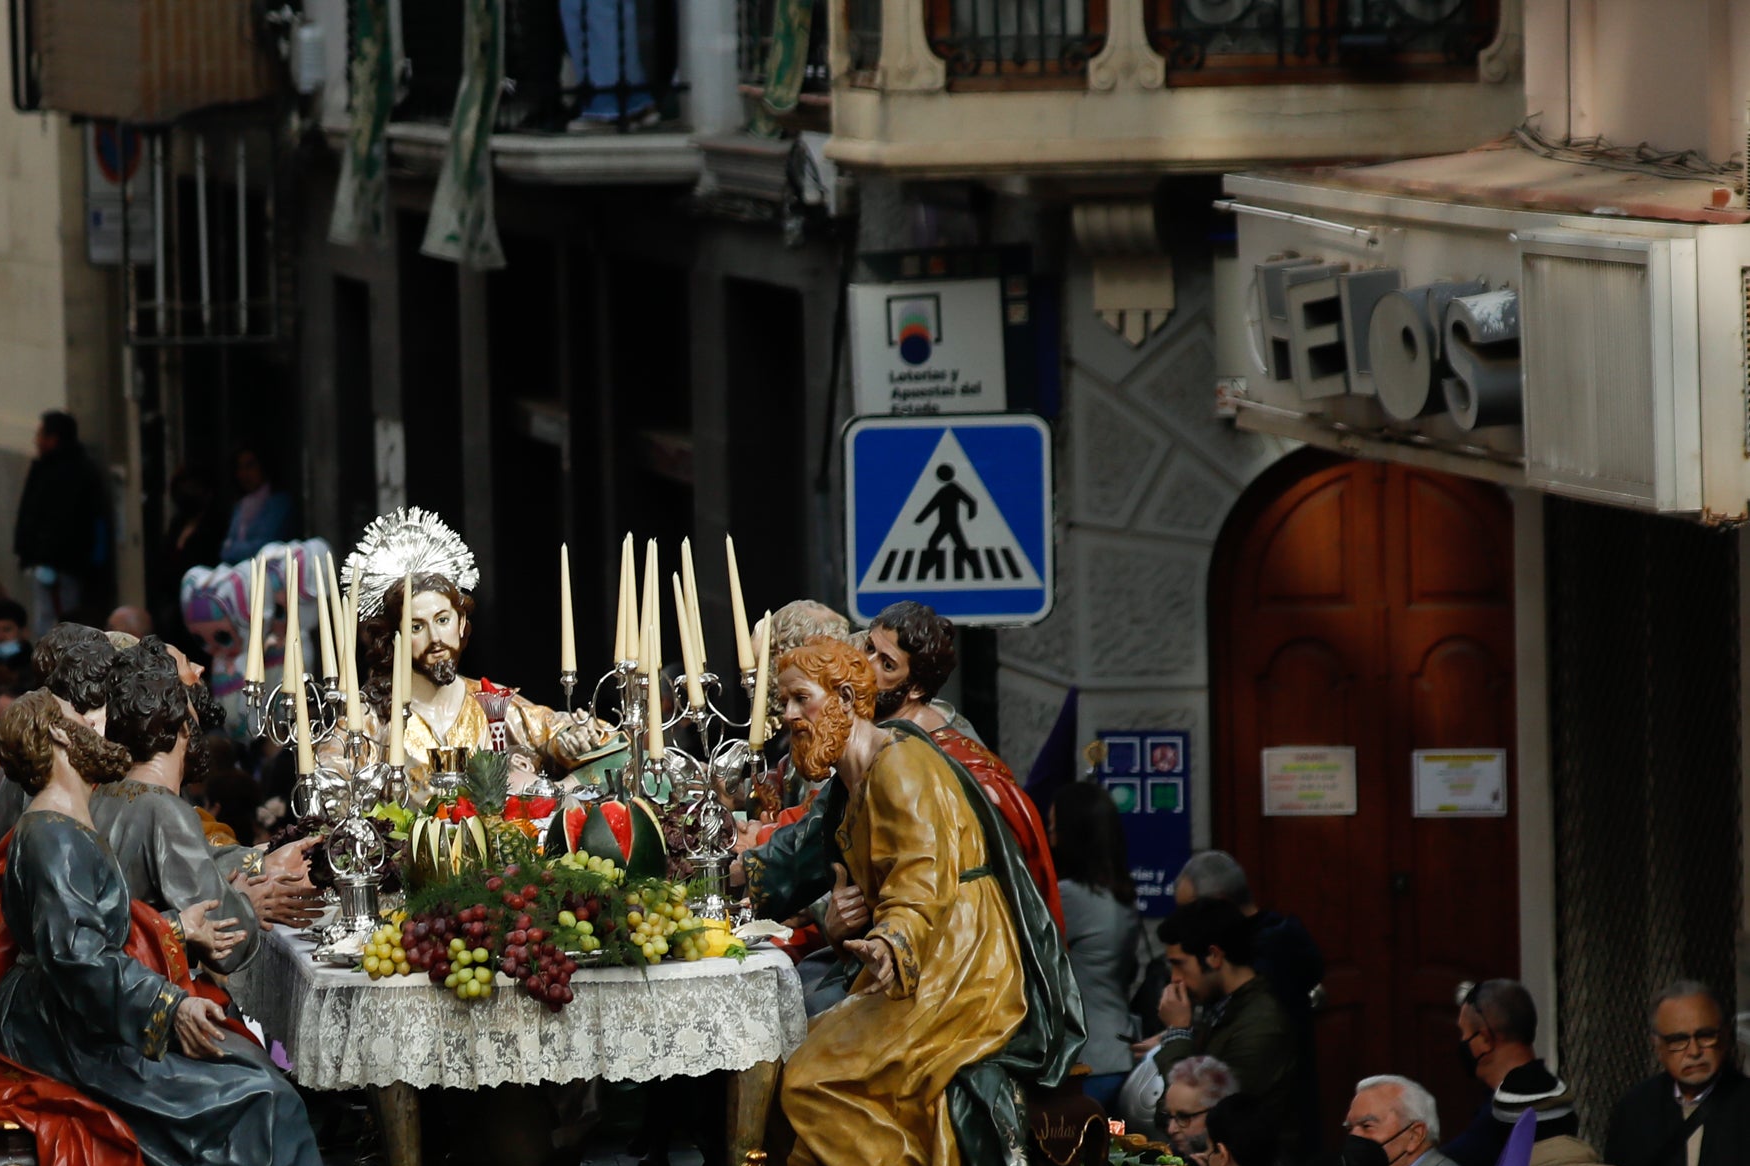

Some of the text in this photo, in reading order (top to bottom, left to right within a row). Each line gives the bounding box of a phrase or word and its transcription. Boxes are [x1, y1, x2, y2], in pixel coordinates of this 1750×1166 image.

[951, 369, 959, 381] y
[892, 380, 982, 400] Apuestas del
[1039, 1111, 1075, 1140] Judas
